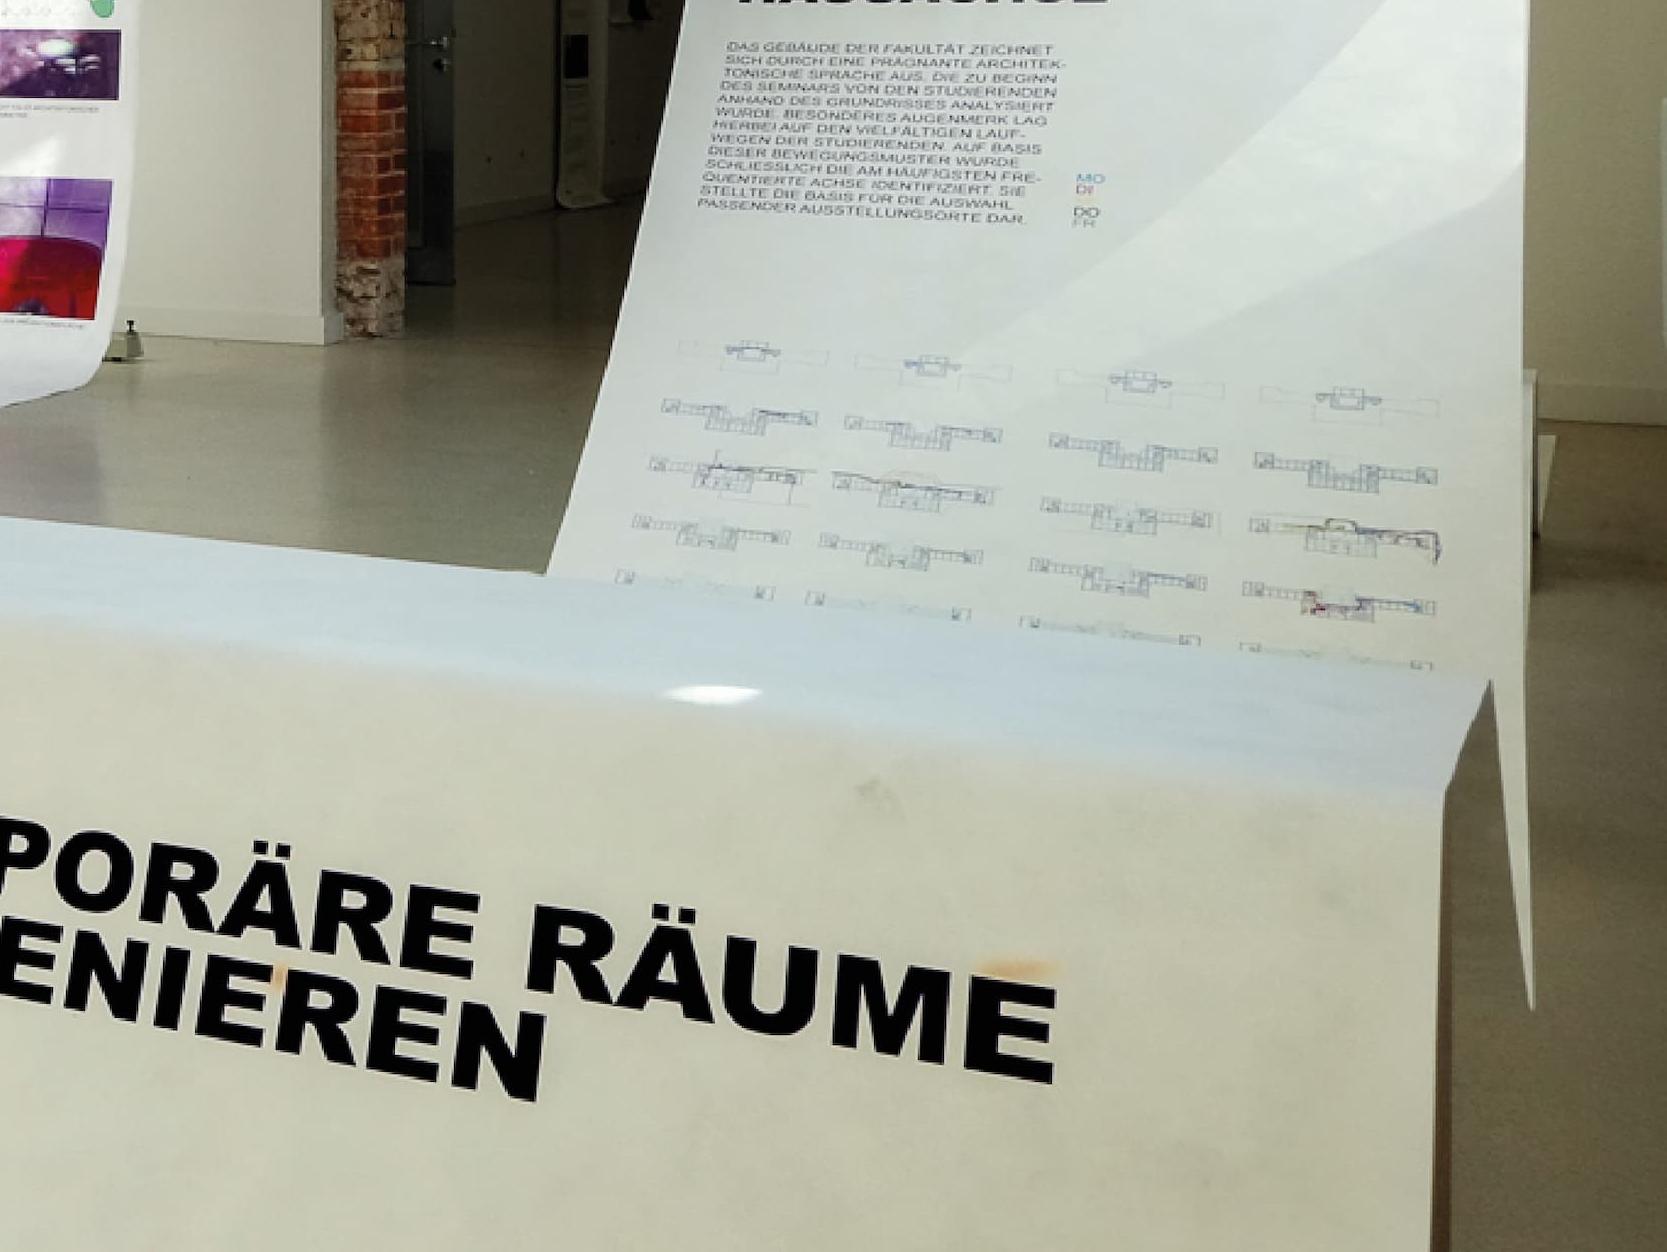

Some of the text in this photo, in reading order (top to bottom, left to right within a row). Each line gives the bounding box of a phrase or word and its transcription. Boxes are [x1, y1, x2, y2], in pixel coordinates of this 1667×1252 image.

[727, 42, 759, 52] DAS
[844, 43, 879, 54] DER
[968, 43, 1054, 56] ZEICHNET
[725, 54, 762, 64] SICH
[768, 56, 823, 66] DURCH
[828, 56, 865, 67] EINE
[724, 67, 804, 79] TONISCHE
[808, 69, 886, 80] SPRACHE
[964, 73, 987, 84] ZU
[993, 73, 1057, 84] BEGINN
[844, 83, 879, 94] VON
[526, 903, 1057, 1084] RÄUME
